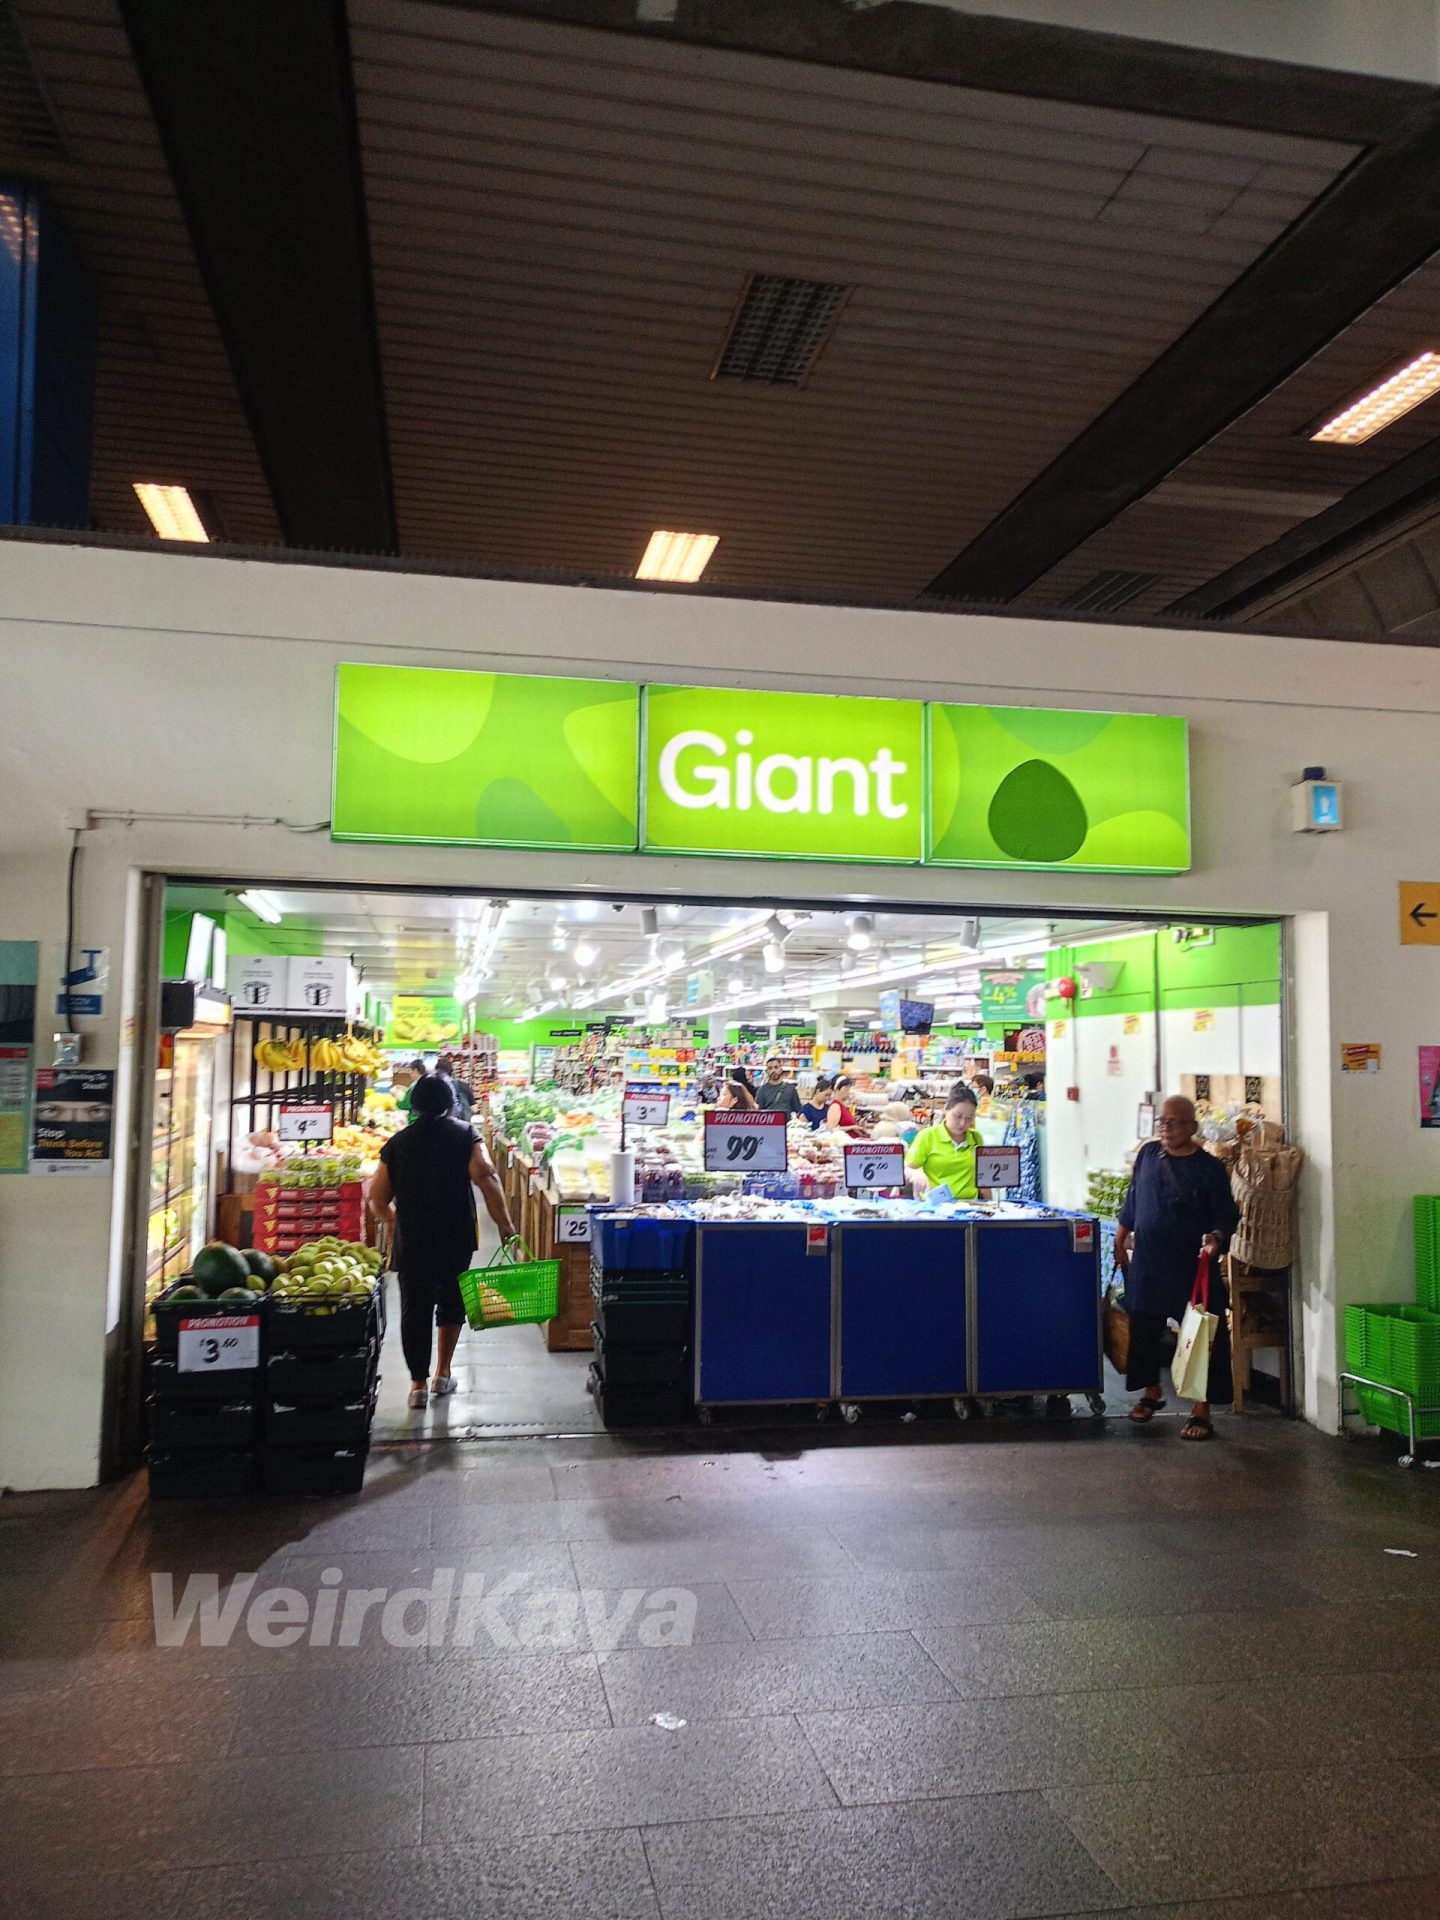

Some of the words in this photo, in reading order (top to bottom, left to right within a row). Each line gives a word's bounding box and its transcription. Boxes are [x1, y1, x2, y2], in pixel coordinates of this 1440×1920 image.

[658, 729, 908, 819] Giant
[714, 1113, 776, 1124] PROMOTION
[851, 1145, 895, 1154] PROMOTION
[187, 1315, 250, 1329] PROMOTION
